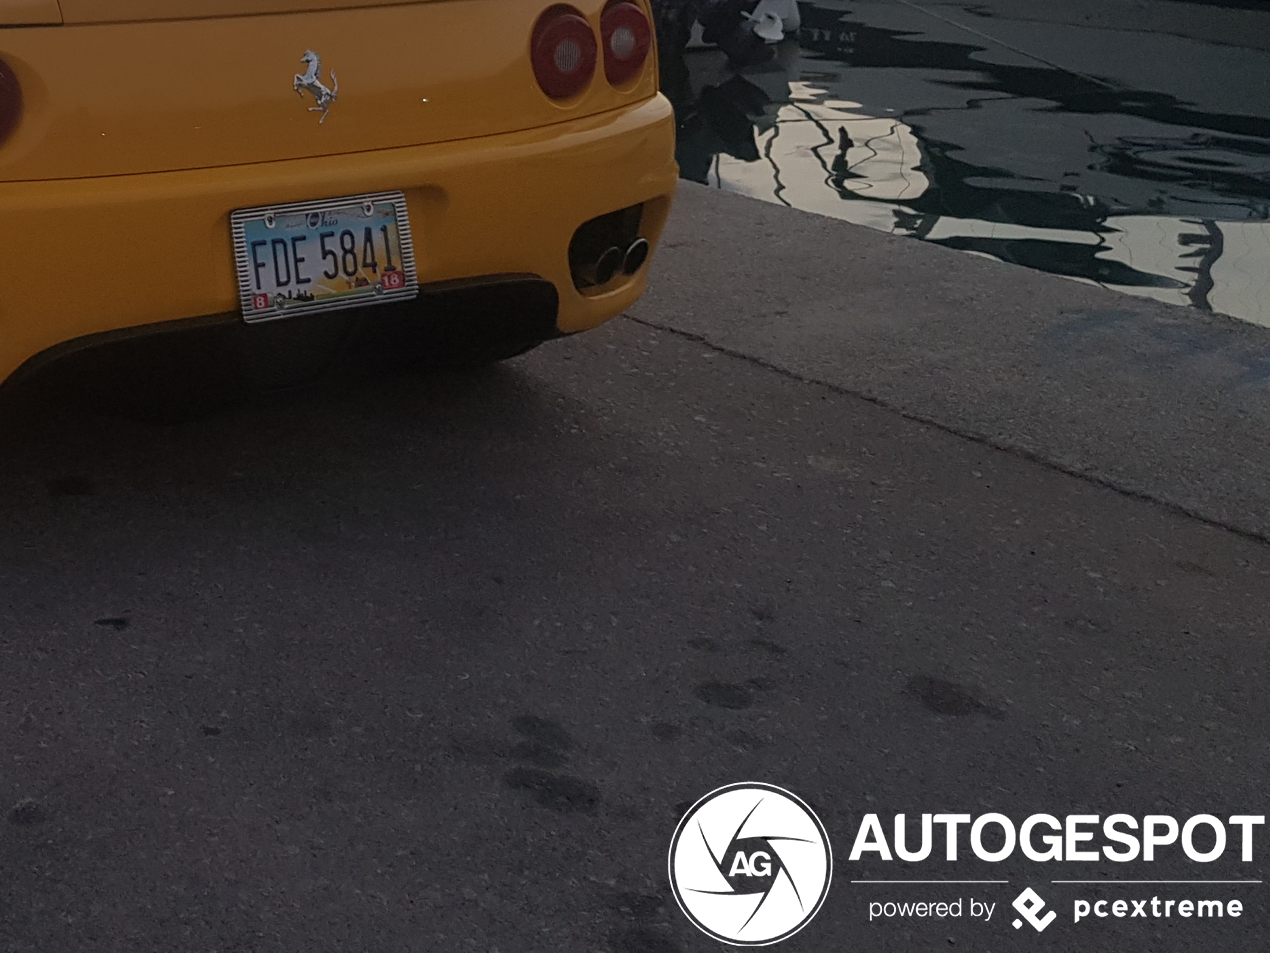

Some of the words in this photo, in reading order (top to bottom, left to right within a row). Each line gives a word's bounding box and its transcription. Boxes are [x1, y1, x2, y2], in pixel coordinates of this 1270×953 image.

[251, 234, 311, 290] FDE
[320, 224, 397, 279] 5841
[381, 273, 400, 286] 18
[255, 296, 265, 308] 8
